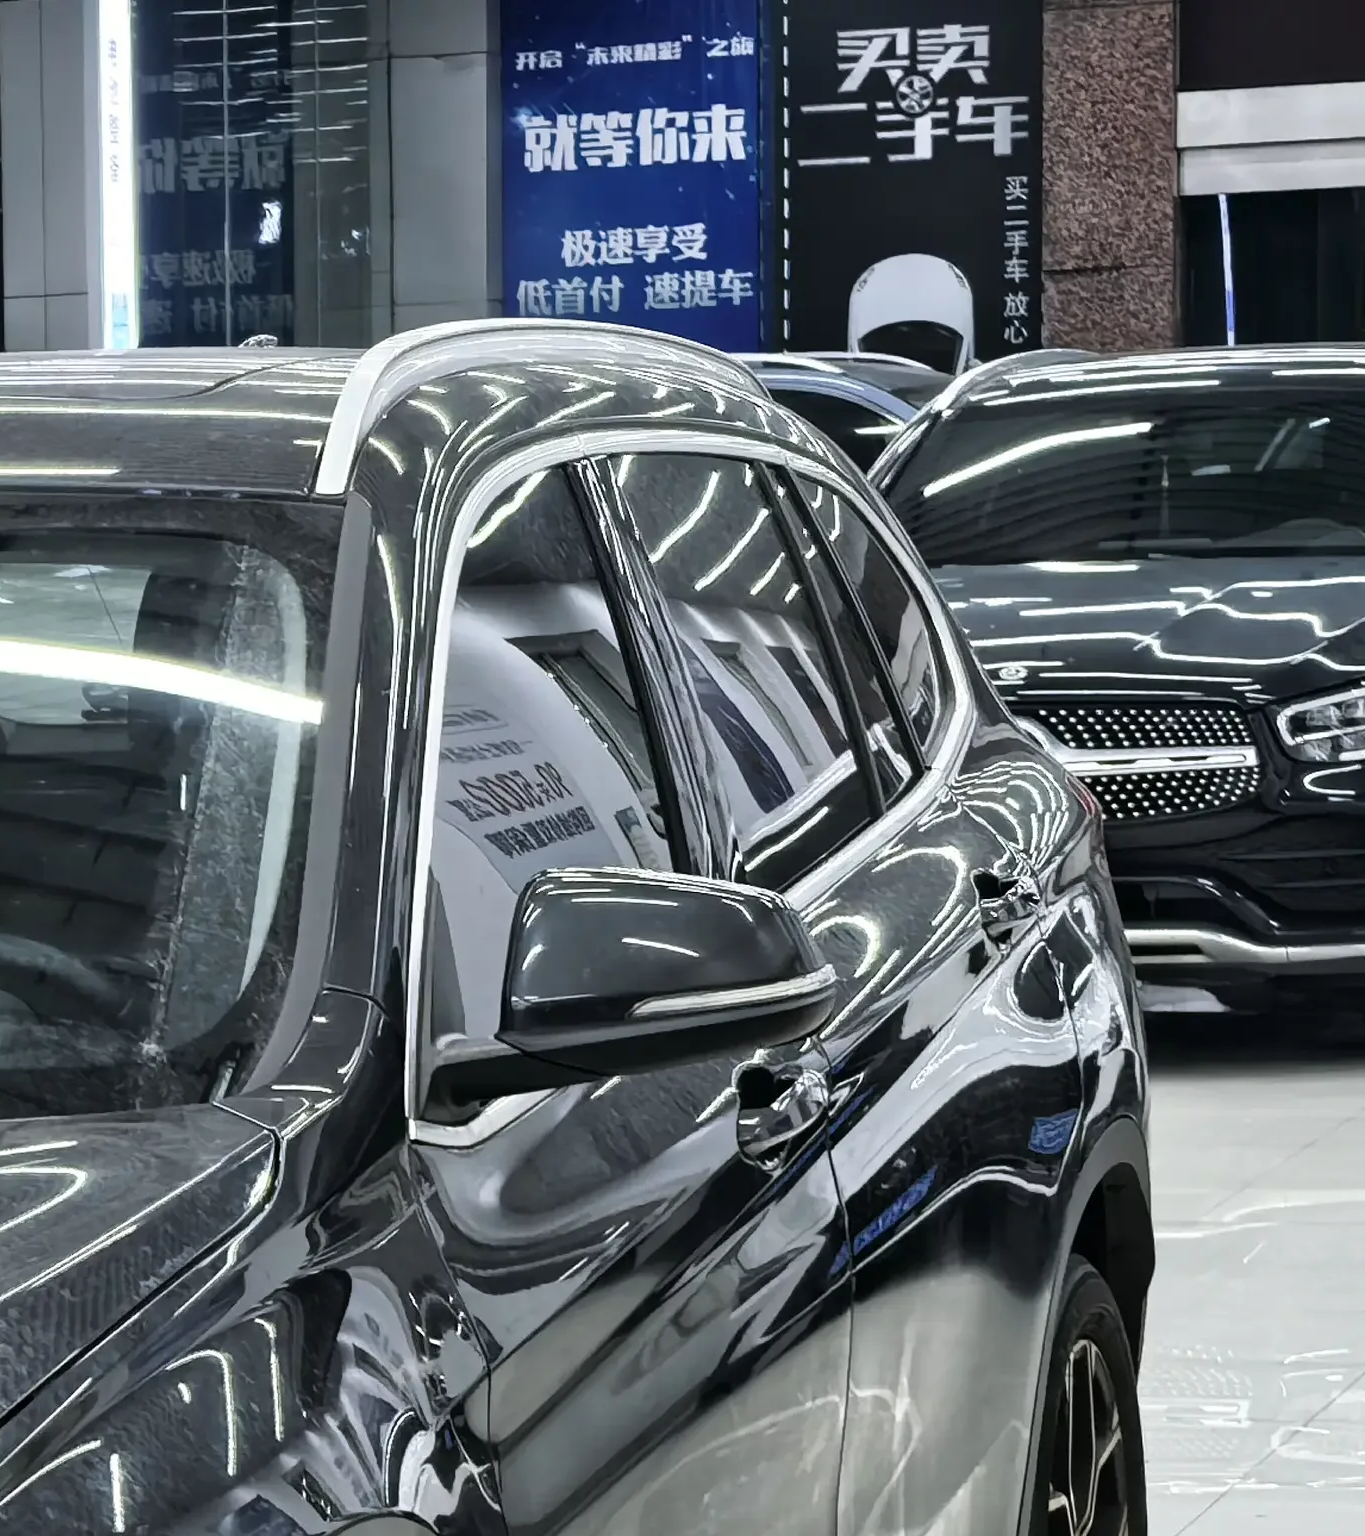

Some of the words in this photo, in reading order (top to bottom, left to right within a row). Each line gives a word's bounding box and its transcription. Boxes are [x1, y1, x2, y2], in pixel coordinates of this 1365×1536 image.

[515, 50, 563, 71] 开启
[701, 31, 755, 58] 之旅
[836, 24, 990, 93] 买卖
[523, 103, 748, 173] 就等你来
[797, 95, 1030, 167] 二手车
[560, 222, 709, 268] 极速享受
[1003, 175, 1030, 283] 买二手车
[516, 275, 624, 317] 低首付
[644, 268, 755, 311] 速提车
[1003, 291, 1030, 344] 放心
